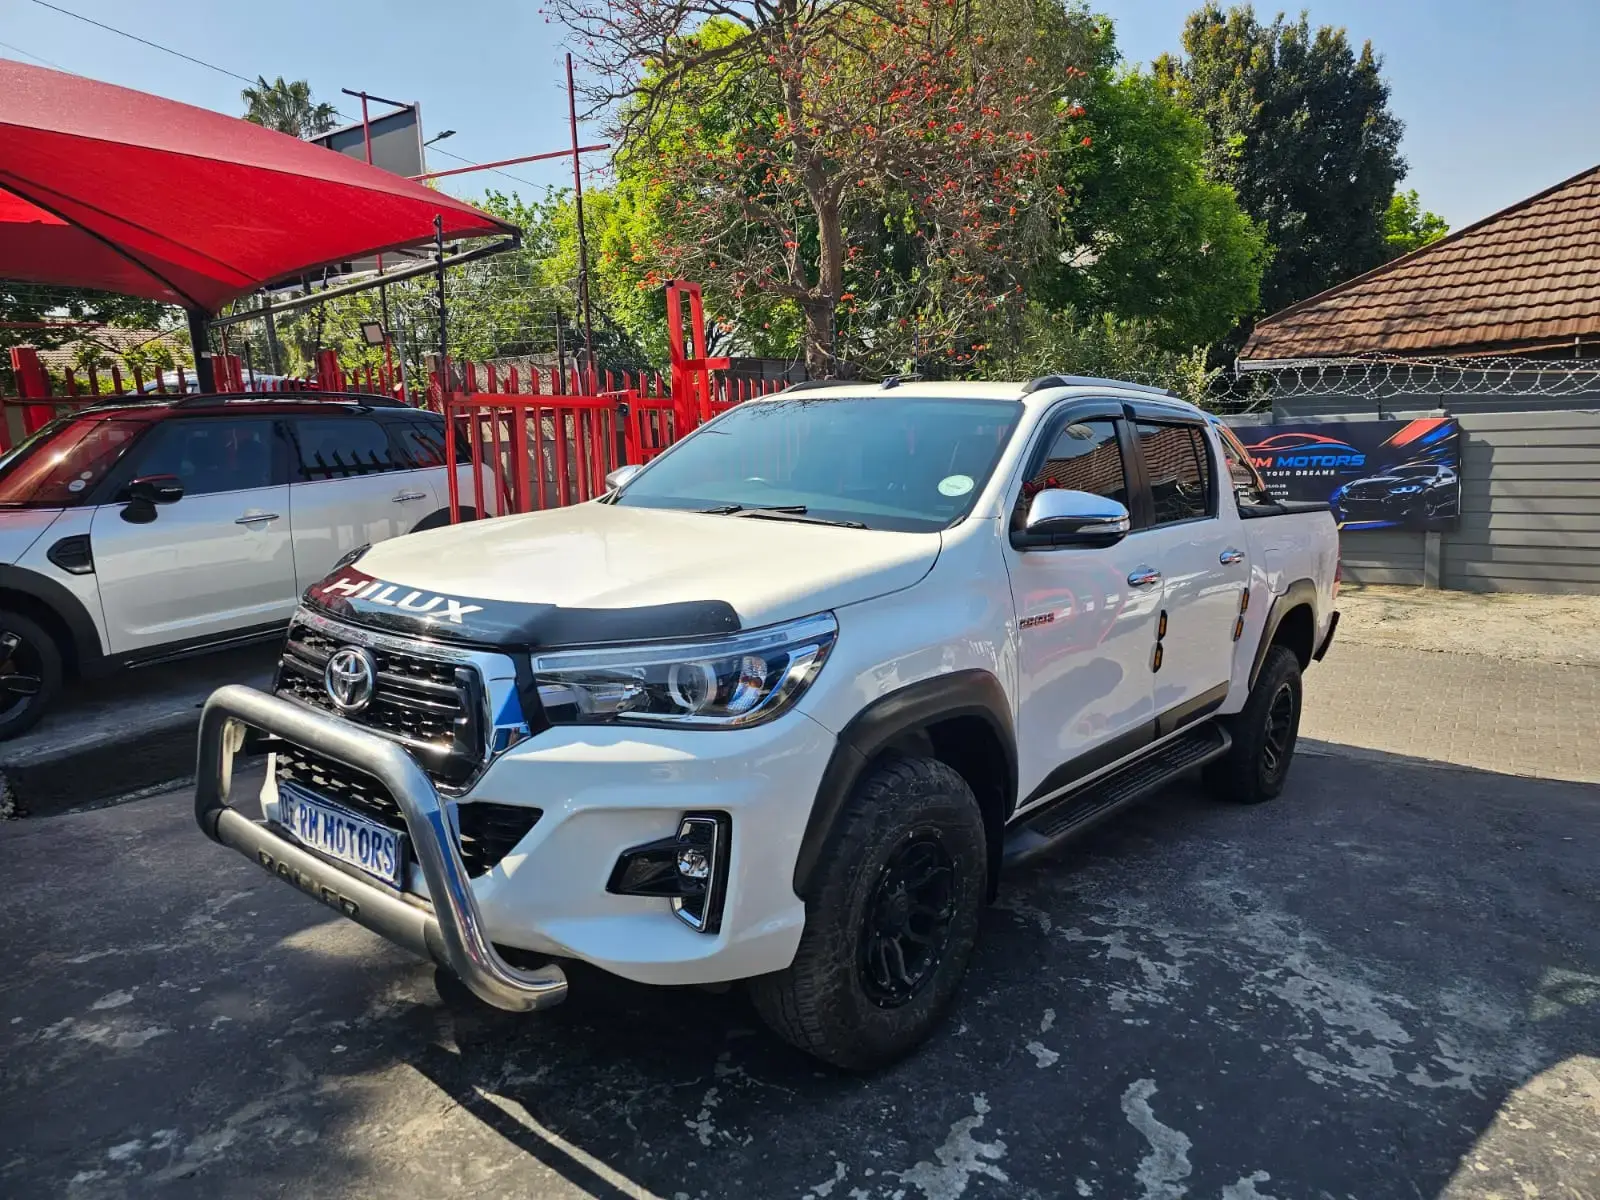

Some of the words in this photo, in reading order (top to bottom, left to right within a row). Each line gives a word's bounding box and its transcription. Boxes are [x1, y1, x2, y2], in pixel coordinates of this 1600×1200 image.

[1276, 454, 1366, 468] MOTORS
[1296, 469, 1336, 477] DREAMS
[321, 577, 484, 624] HILUX
[299, 803, 319, 845] RM
[323, 812, 394, 875] MOTORS
